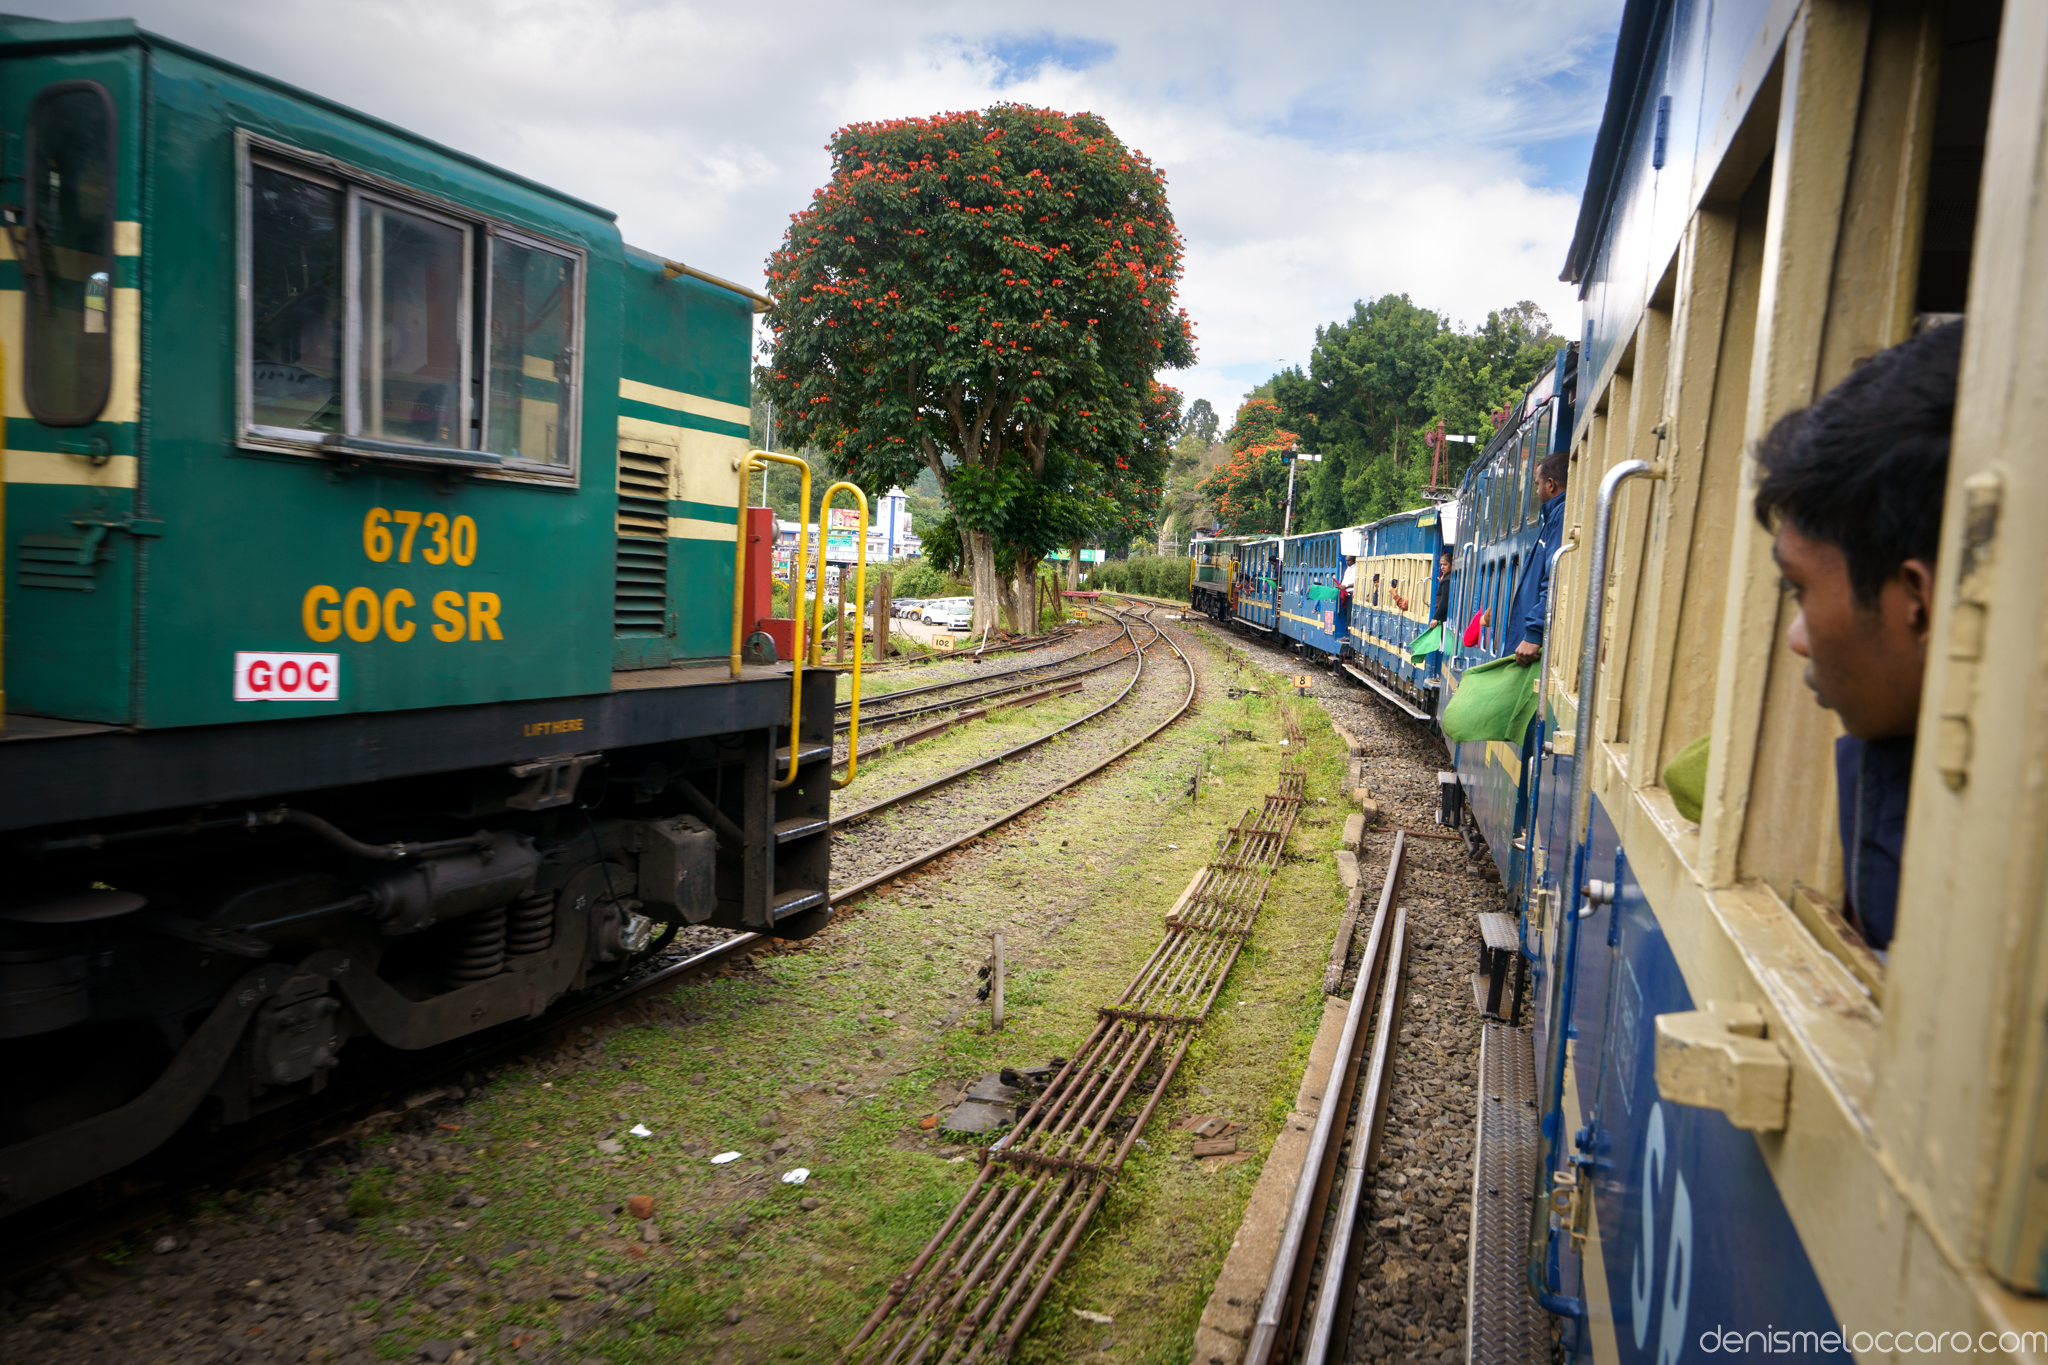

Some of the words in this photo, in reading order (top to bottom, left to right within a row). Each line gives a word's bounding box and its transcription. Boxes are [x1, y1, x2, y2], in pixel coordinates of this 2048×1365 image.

[363, 507, 478, 567] 6730
[302, 585, 417, 643] GOC
[432, 591, 504, 643] SR
[935, 639, 950, 647] 102
[248, 660, 330, 693] GOC
[1300, 676, 1305, 685] 8
[524, 722, 551, 737] LIFT
[552, 718, 584, 734] HERE
